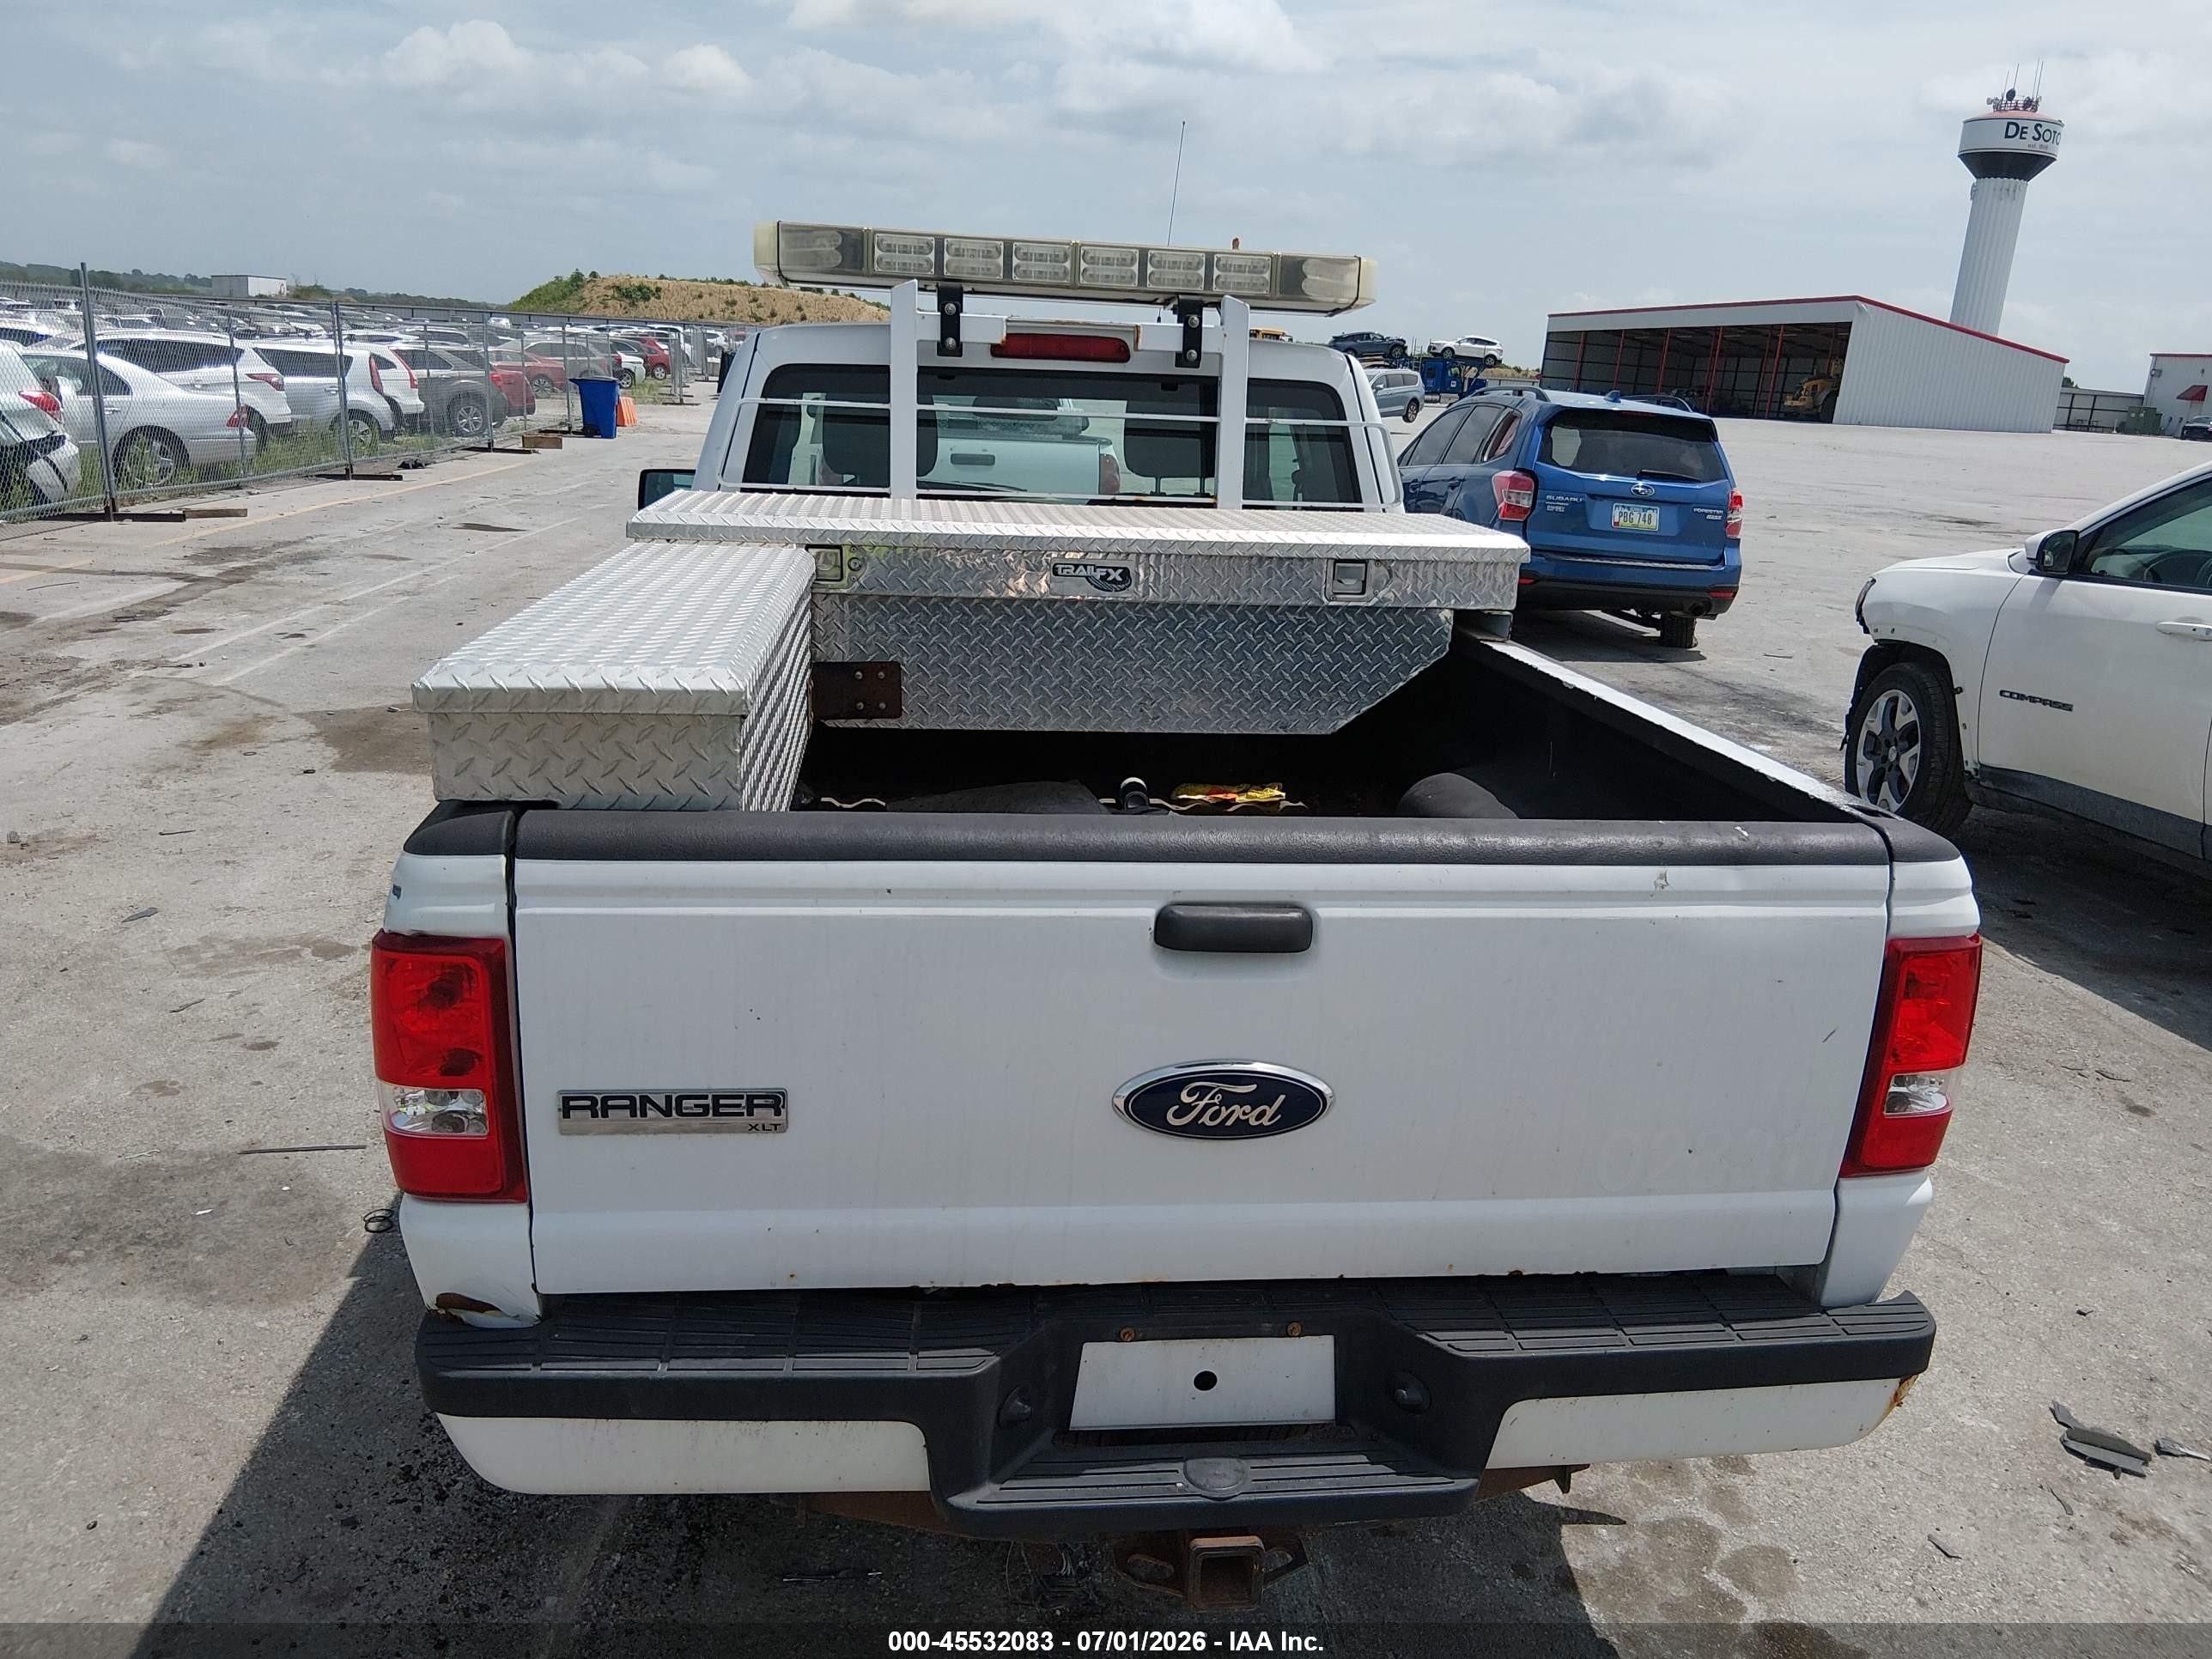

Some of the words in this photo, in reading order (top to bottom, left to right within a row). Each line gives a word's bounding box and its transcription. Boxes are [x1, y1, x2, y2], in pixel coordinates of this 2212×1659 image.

[1546, 495, 1582, 503] SUBARU
[1619, 511, 1634, 523] PBG
[1638, 513, 1652, 525] 748
[1999, 690, 2073, 712] COMPASS
[561, 1094, 785, 1119] RANGER
[1166, 1081, 1286, 1127] Ford
[748, 1123, 781, 1132] XLT
